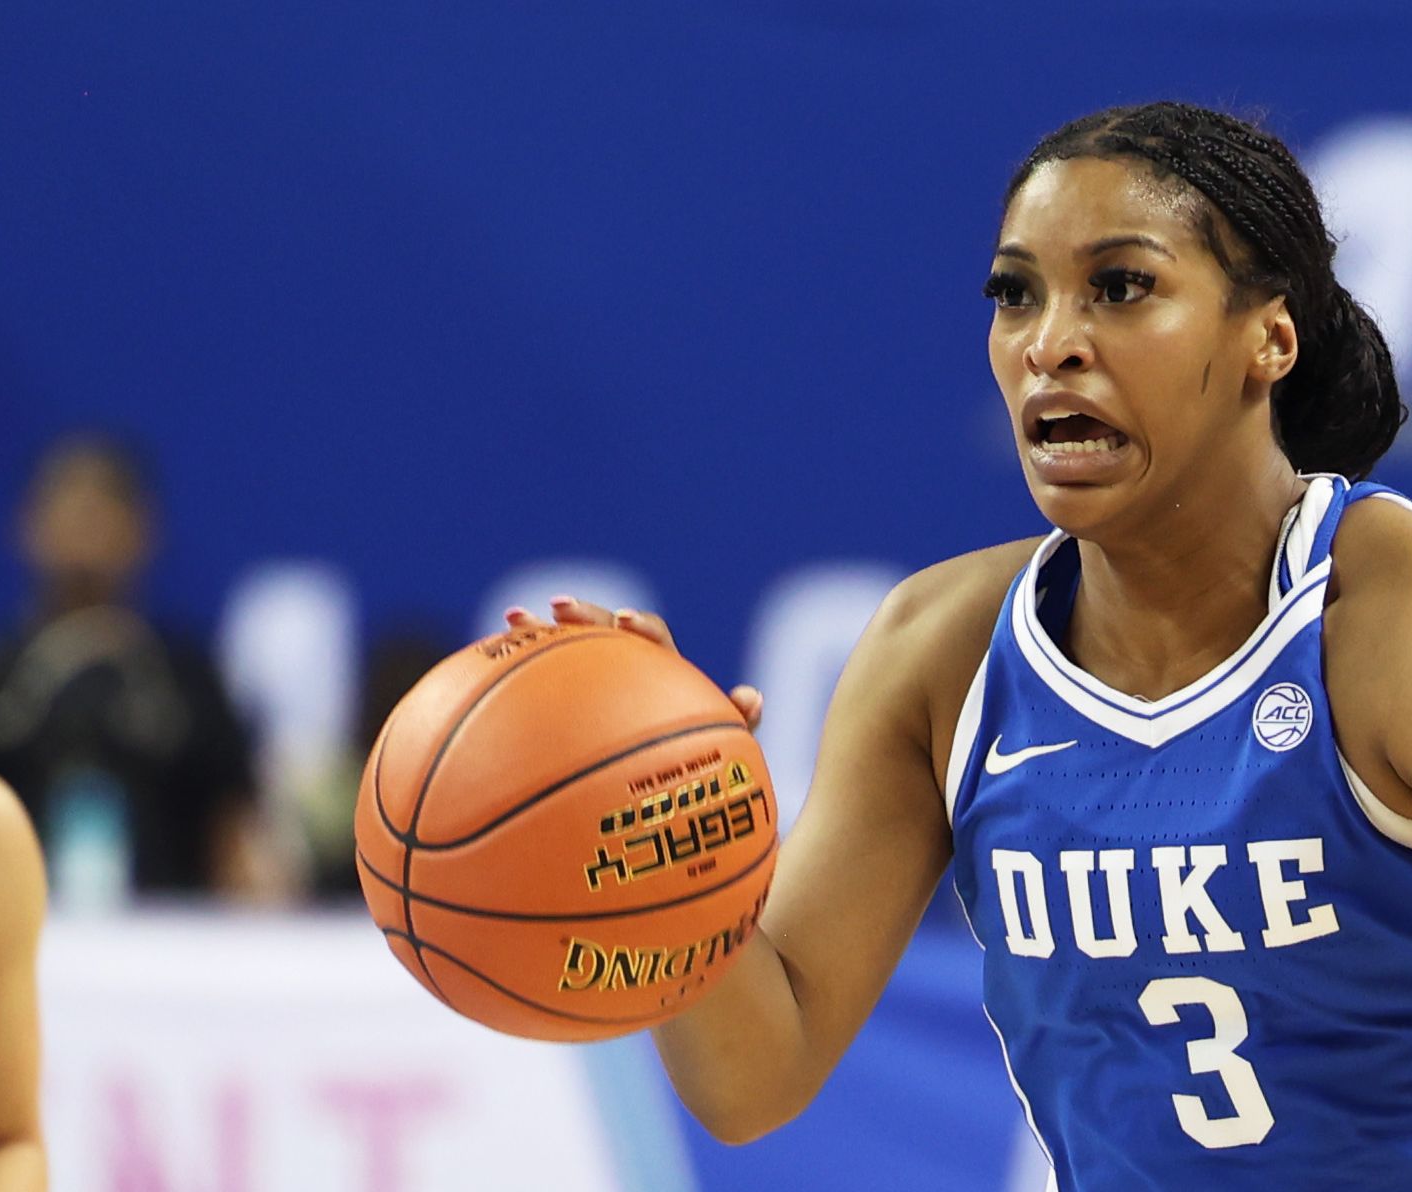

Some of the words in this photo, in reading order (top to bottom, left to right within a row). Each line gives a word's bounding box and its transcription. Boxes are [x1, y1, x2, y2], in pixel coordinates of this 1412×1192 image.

[1263, 705, 1309, 720] ACC
[584, 788, 770, 892] LEGACY
[600, 773, 726, 839] 1000
[991, 837, 1341, 960] DUKE
[1137, 976, 1276, 1149] 3
